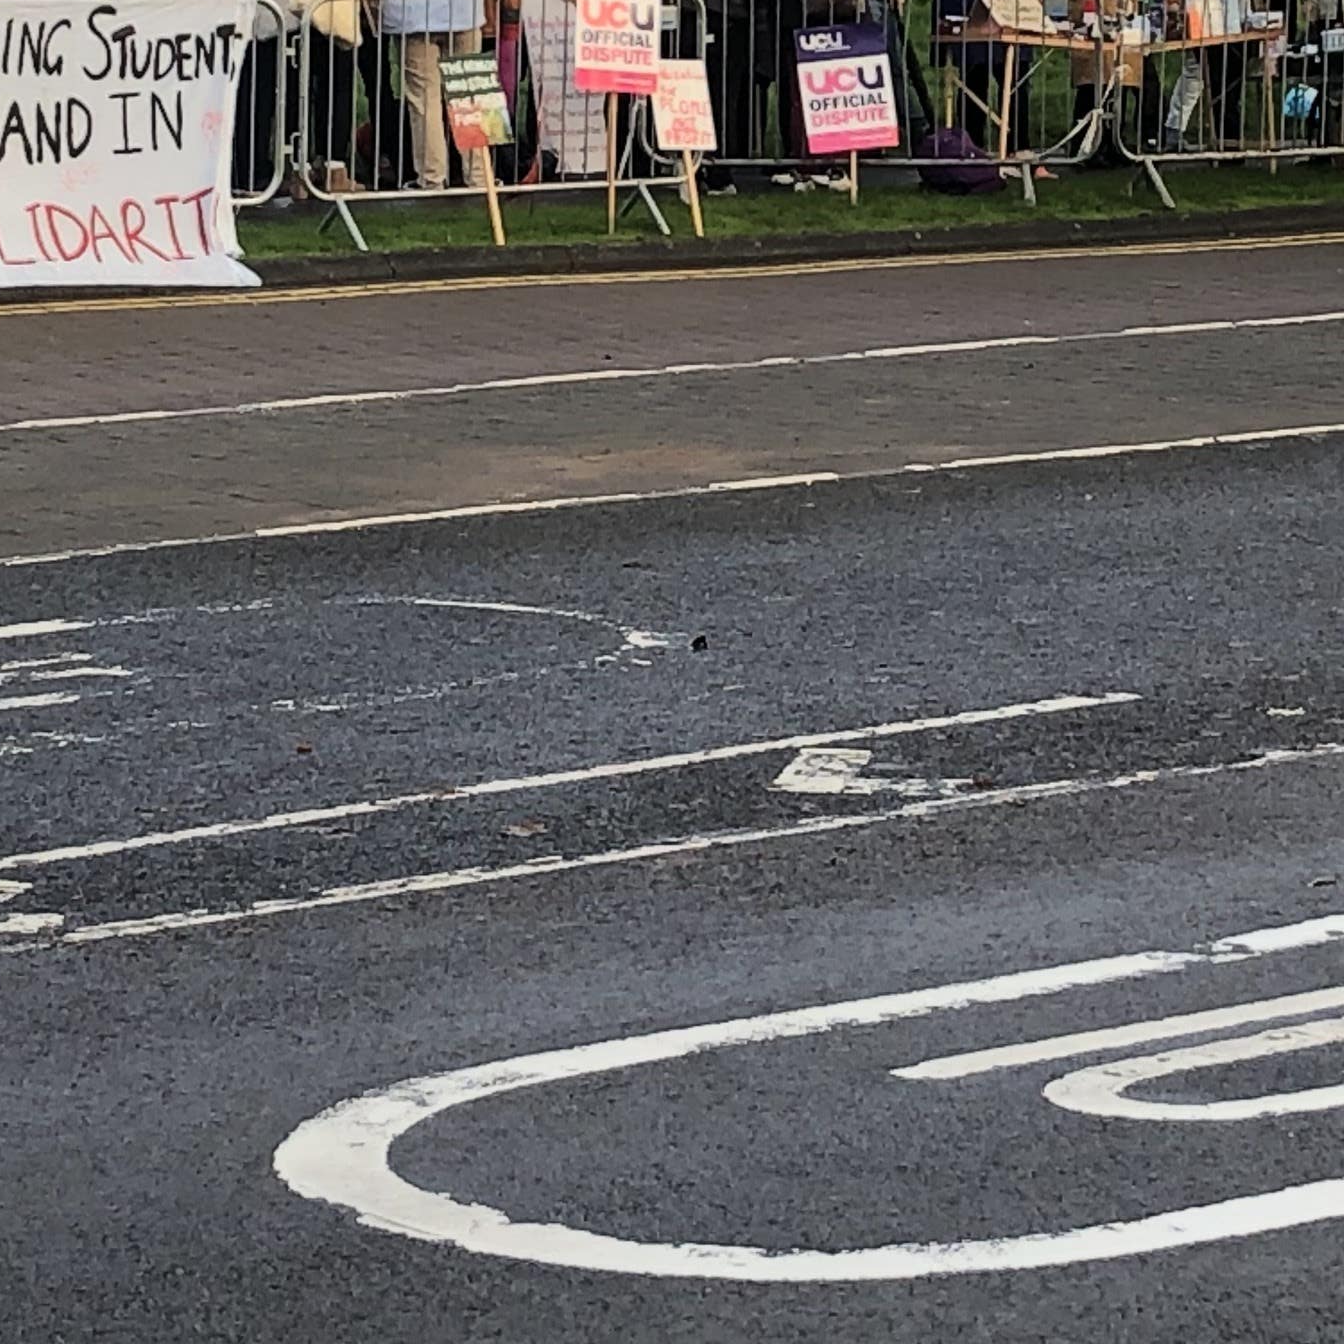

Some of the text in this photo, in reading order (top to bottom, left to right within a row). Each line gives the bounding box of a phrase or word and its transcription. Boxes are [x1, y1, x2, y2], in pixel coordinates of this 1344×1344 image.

[582, 0, 654, 31] UCU
[582, 29, 654, 48] OFFICIAL
[799, 31, 843, 51] UCU
[581, 46, 654, 66] DISPUTE
[804, 65, 885, 95] UCU
[809, 92, 888, 112] OFFICIAL
[108, 90, 184, 154] IN
[811, 106, 889, 127] DISPUTE
